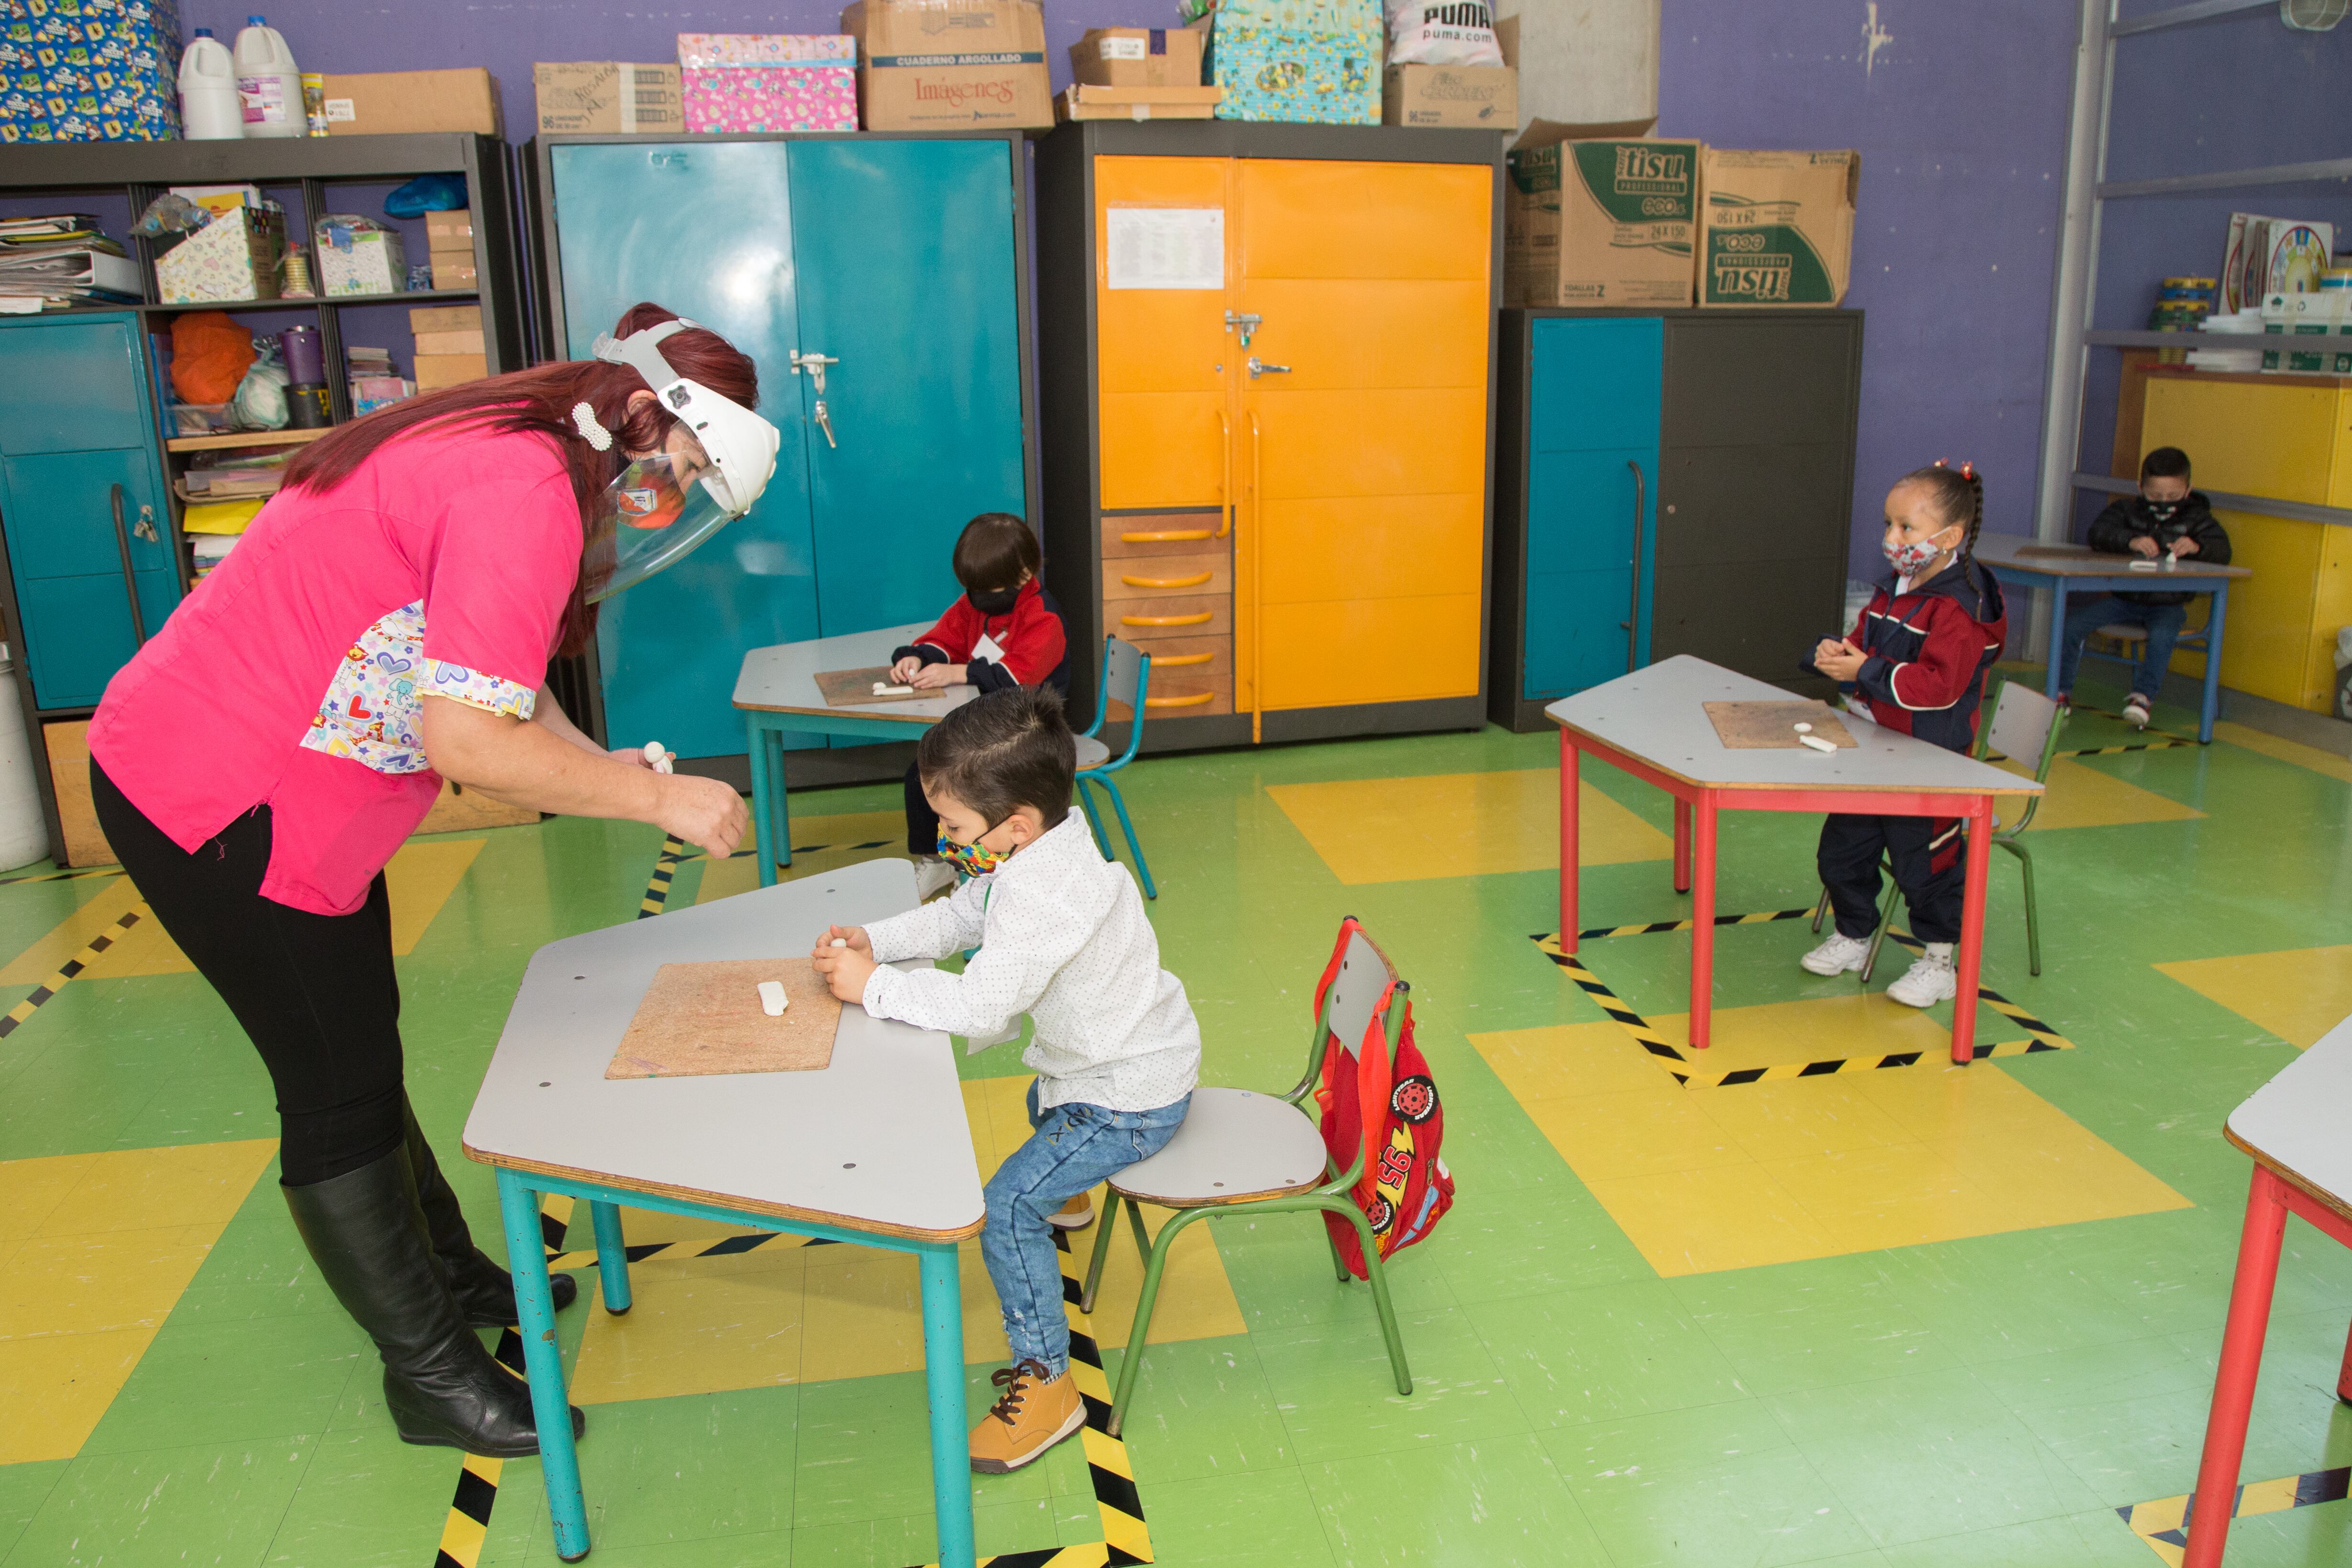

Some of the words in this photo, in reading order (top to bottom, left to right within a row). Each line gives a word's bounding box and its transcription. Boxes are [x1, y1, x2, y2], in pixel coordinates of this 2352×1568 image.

[1424, 3, 1491, 29] PUMA
[1422, 29, 1493, 44] puma.com
[896, 55, 956, 66] CUADERNO
[958, 54, 1022, 65] ARGOLLADO
[914, 77, 1013, 108] Imágenes
[1627, 149, 1682, 179] tisu
[1721, 270, 1780, 299] tisu
[1392, 1078, 1415, 1111] LIGHTYEAR
[1415, 1086, 1434, 1120] LIGHTYEAR
[1378, 1146, 1411, 1188] 95
[1371, 1202, 1390, 1230] LIGHTYEA
